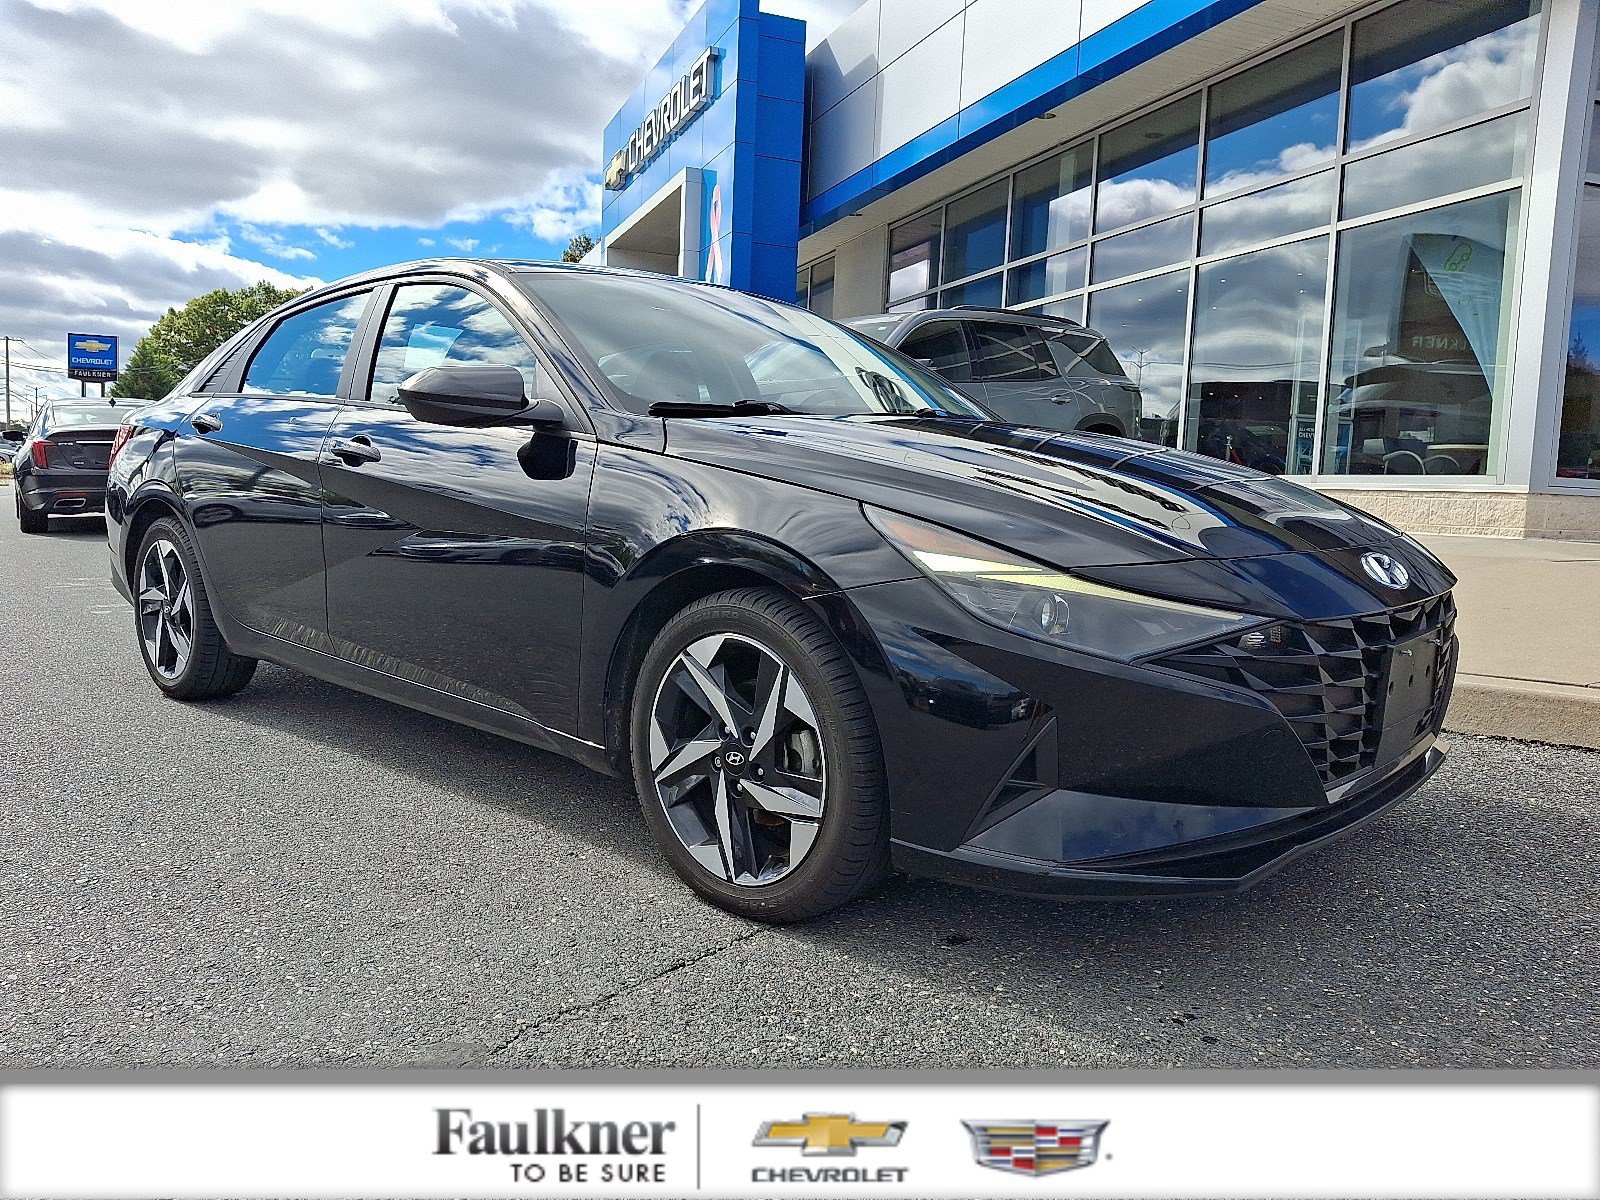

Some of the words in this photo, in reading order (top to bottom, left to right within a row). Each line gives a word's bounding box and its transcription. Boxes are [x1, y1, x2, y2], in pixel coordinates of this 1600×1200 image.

[628, 46, 717, 172] CHEVROLET
[71, 357, 114, 366] CHEVROLET
[74, 370, 111, 378] FAULKNER
